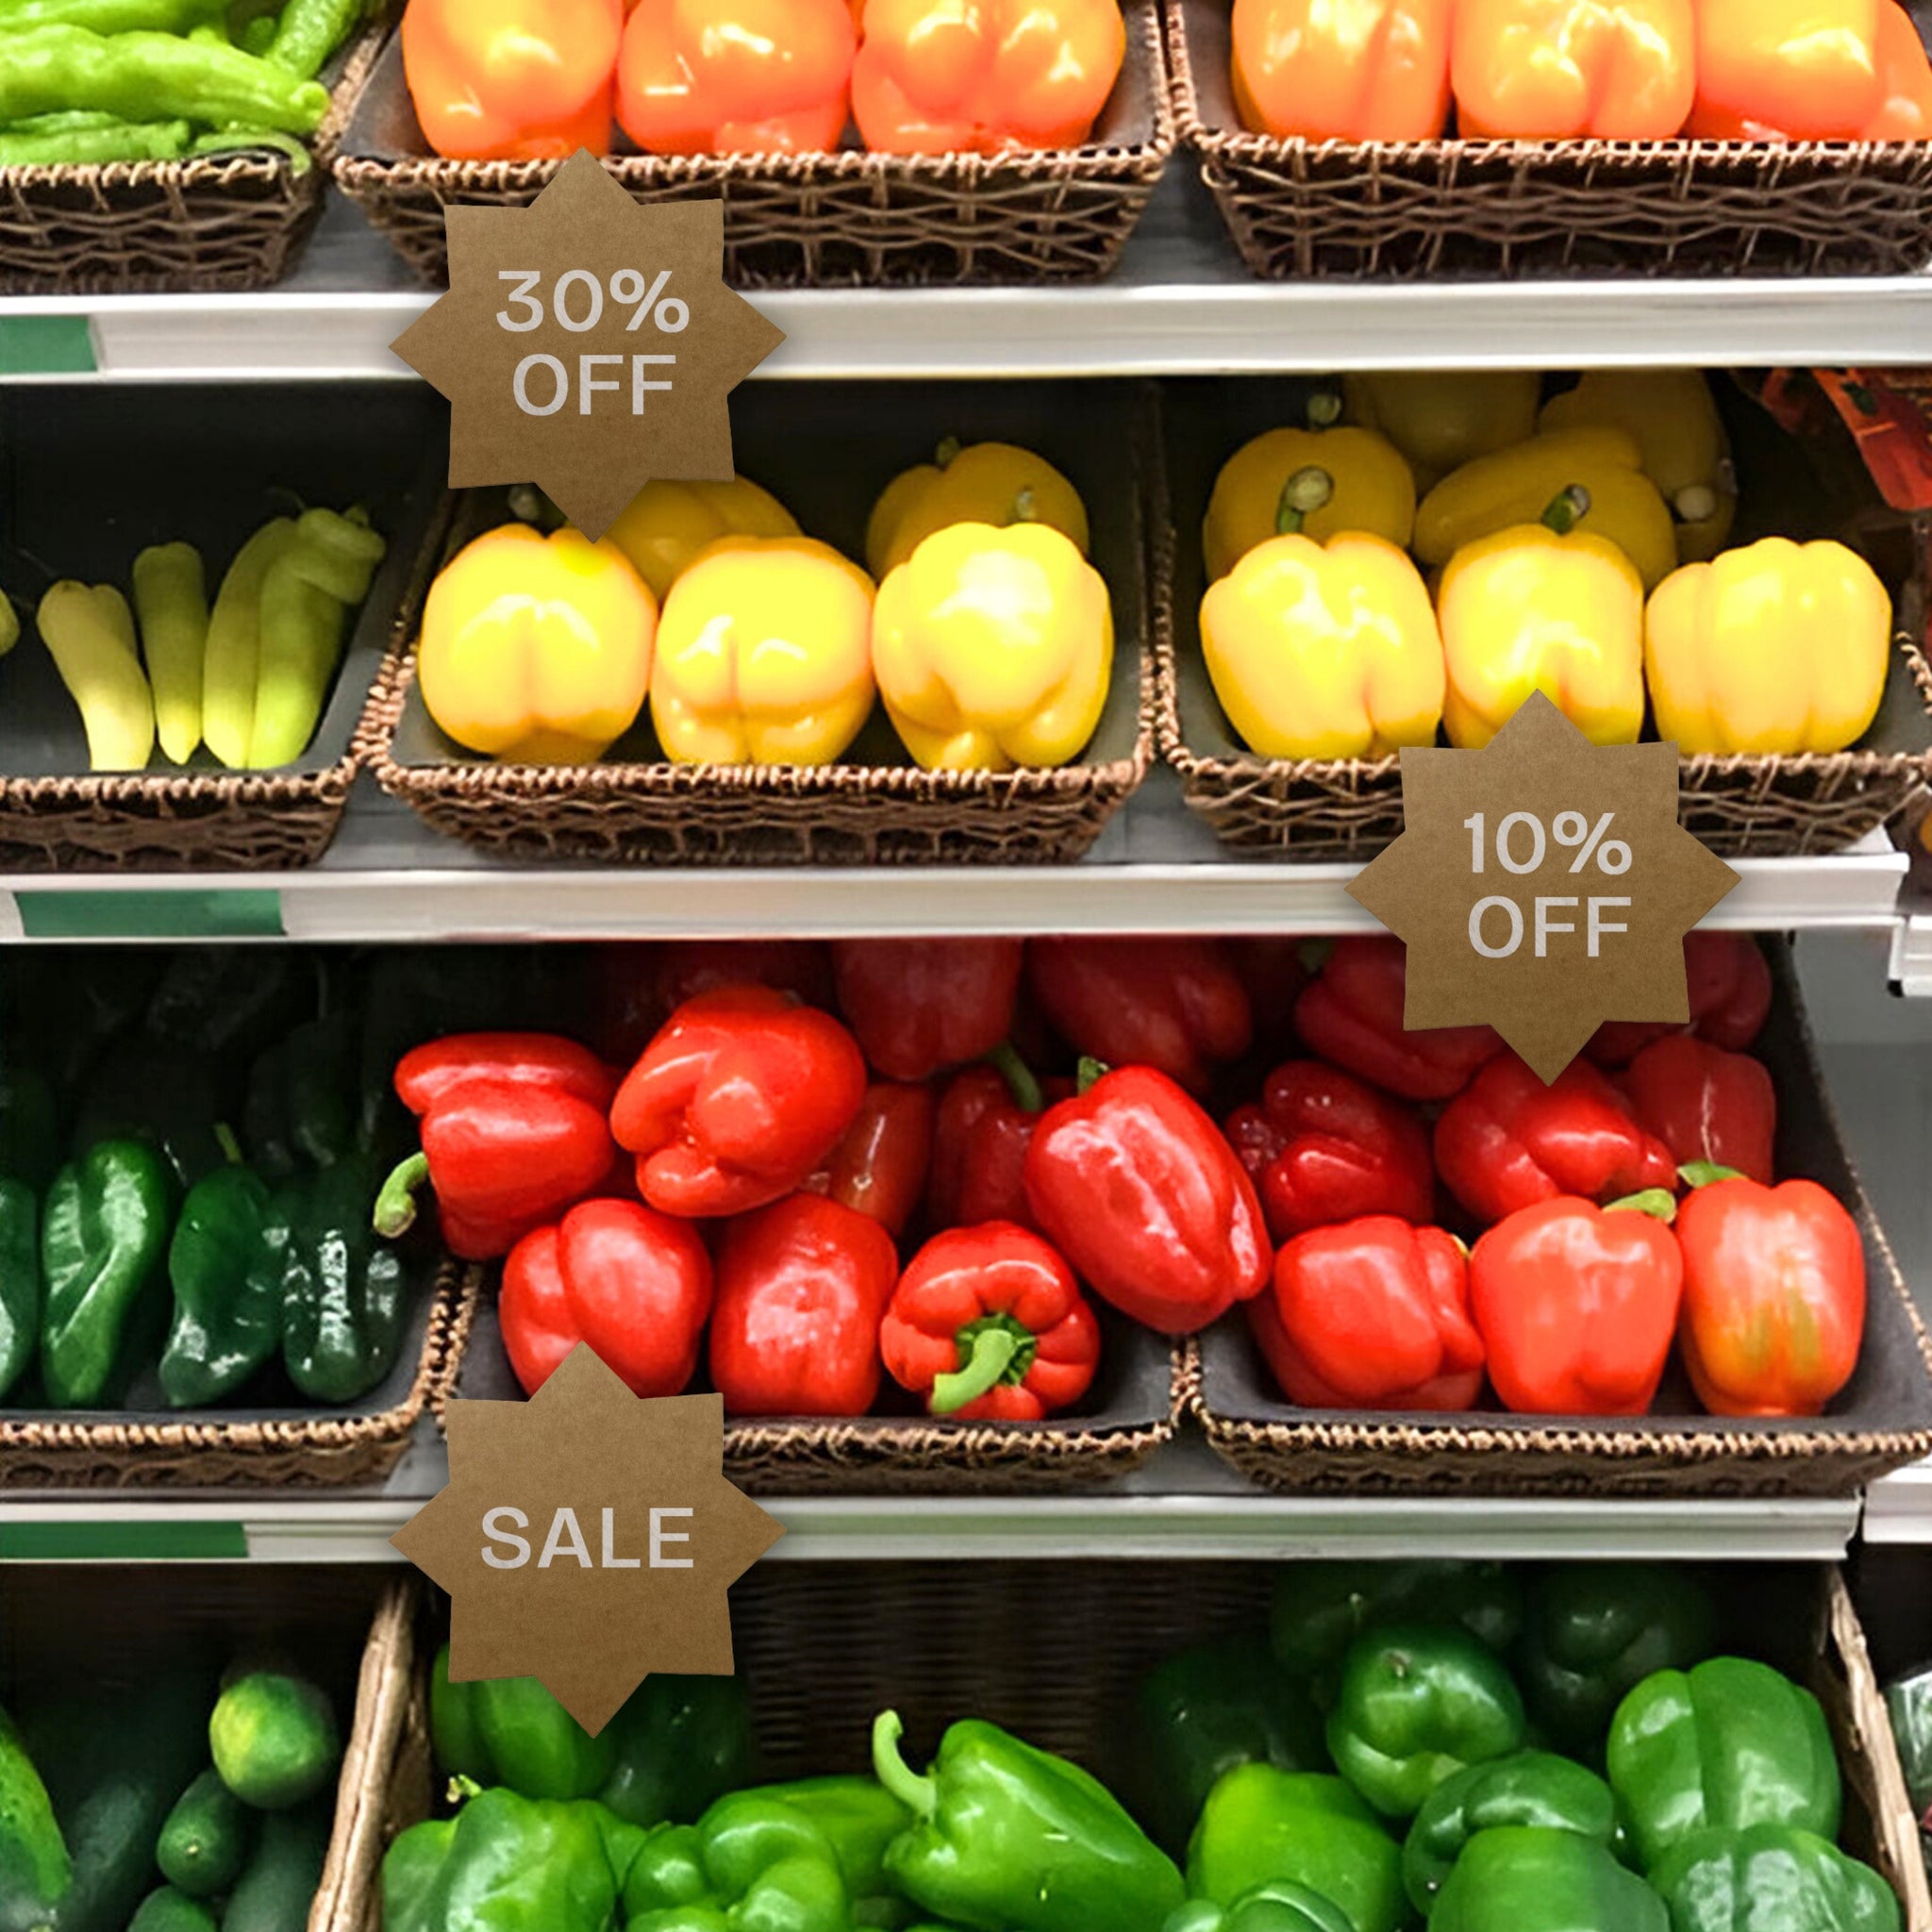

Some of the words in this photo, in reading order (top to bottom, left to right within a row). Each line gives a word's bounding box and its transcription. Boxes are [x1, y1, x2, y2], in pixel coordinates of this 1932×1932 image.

[497, 269, 691, 334] 30%
[514, 354, 677, 417] OFF
[1464, 811, 1634, 876] 10%
[1469, 896, 1633, 959] OFF
[482, 1507, 695, 1570] SALE
